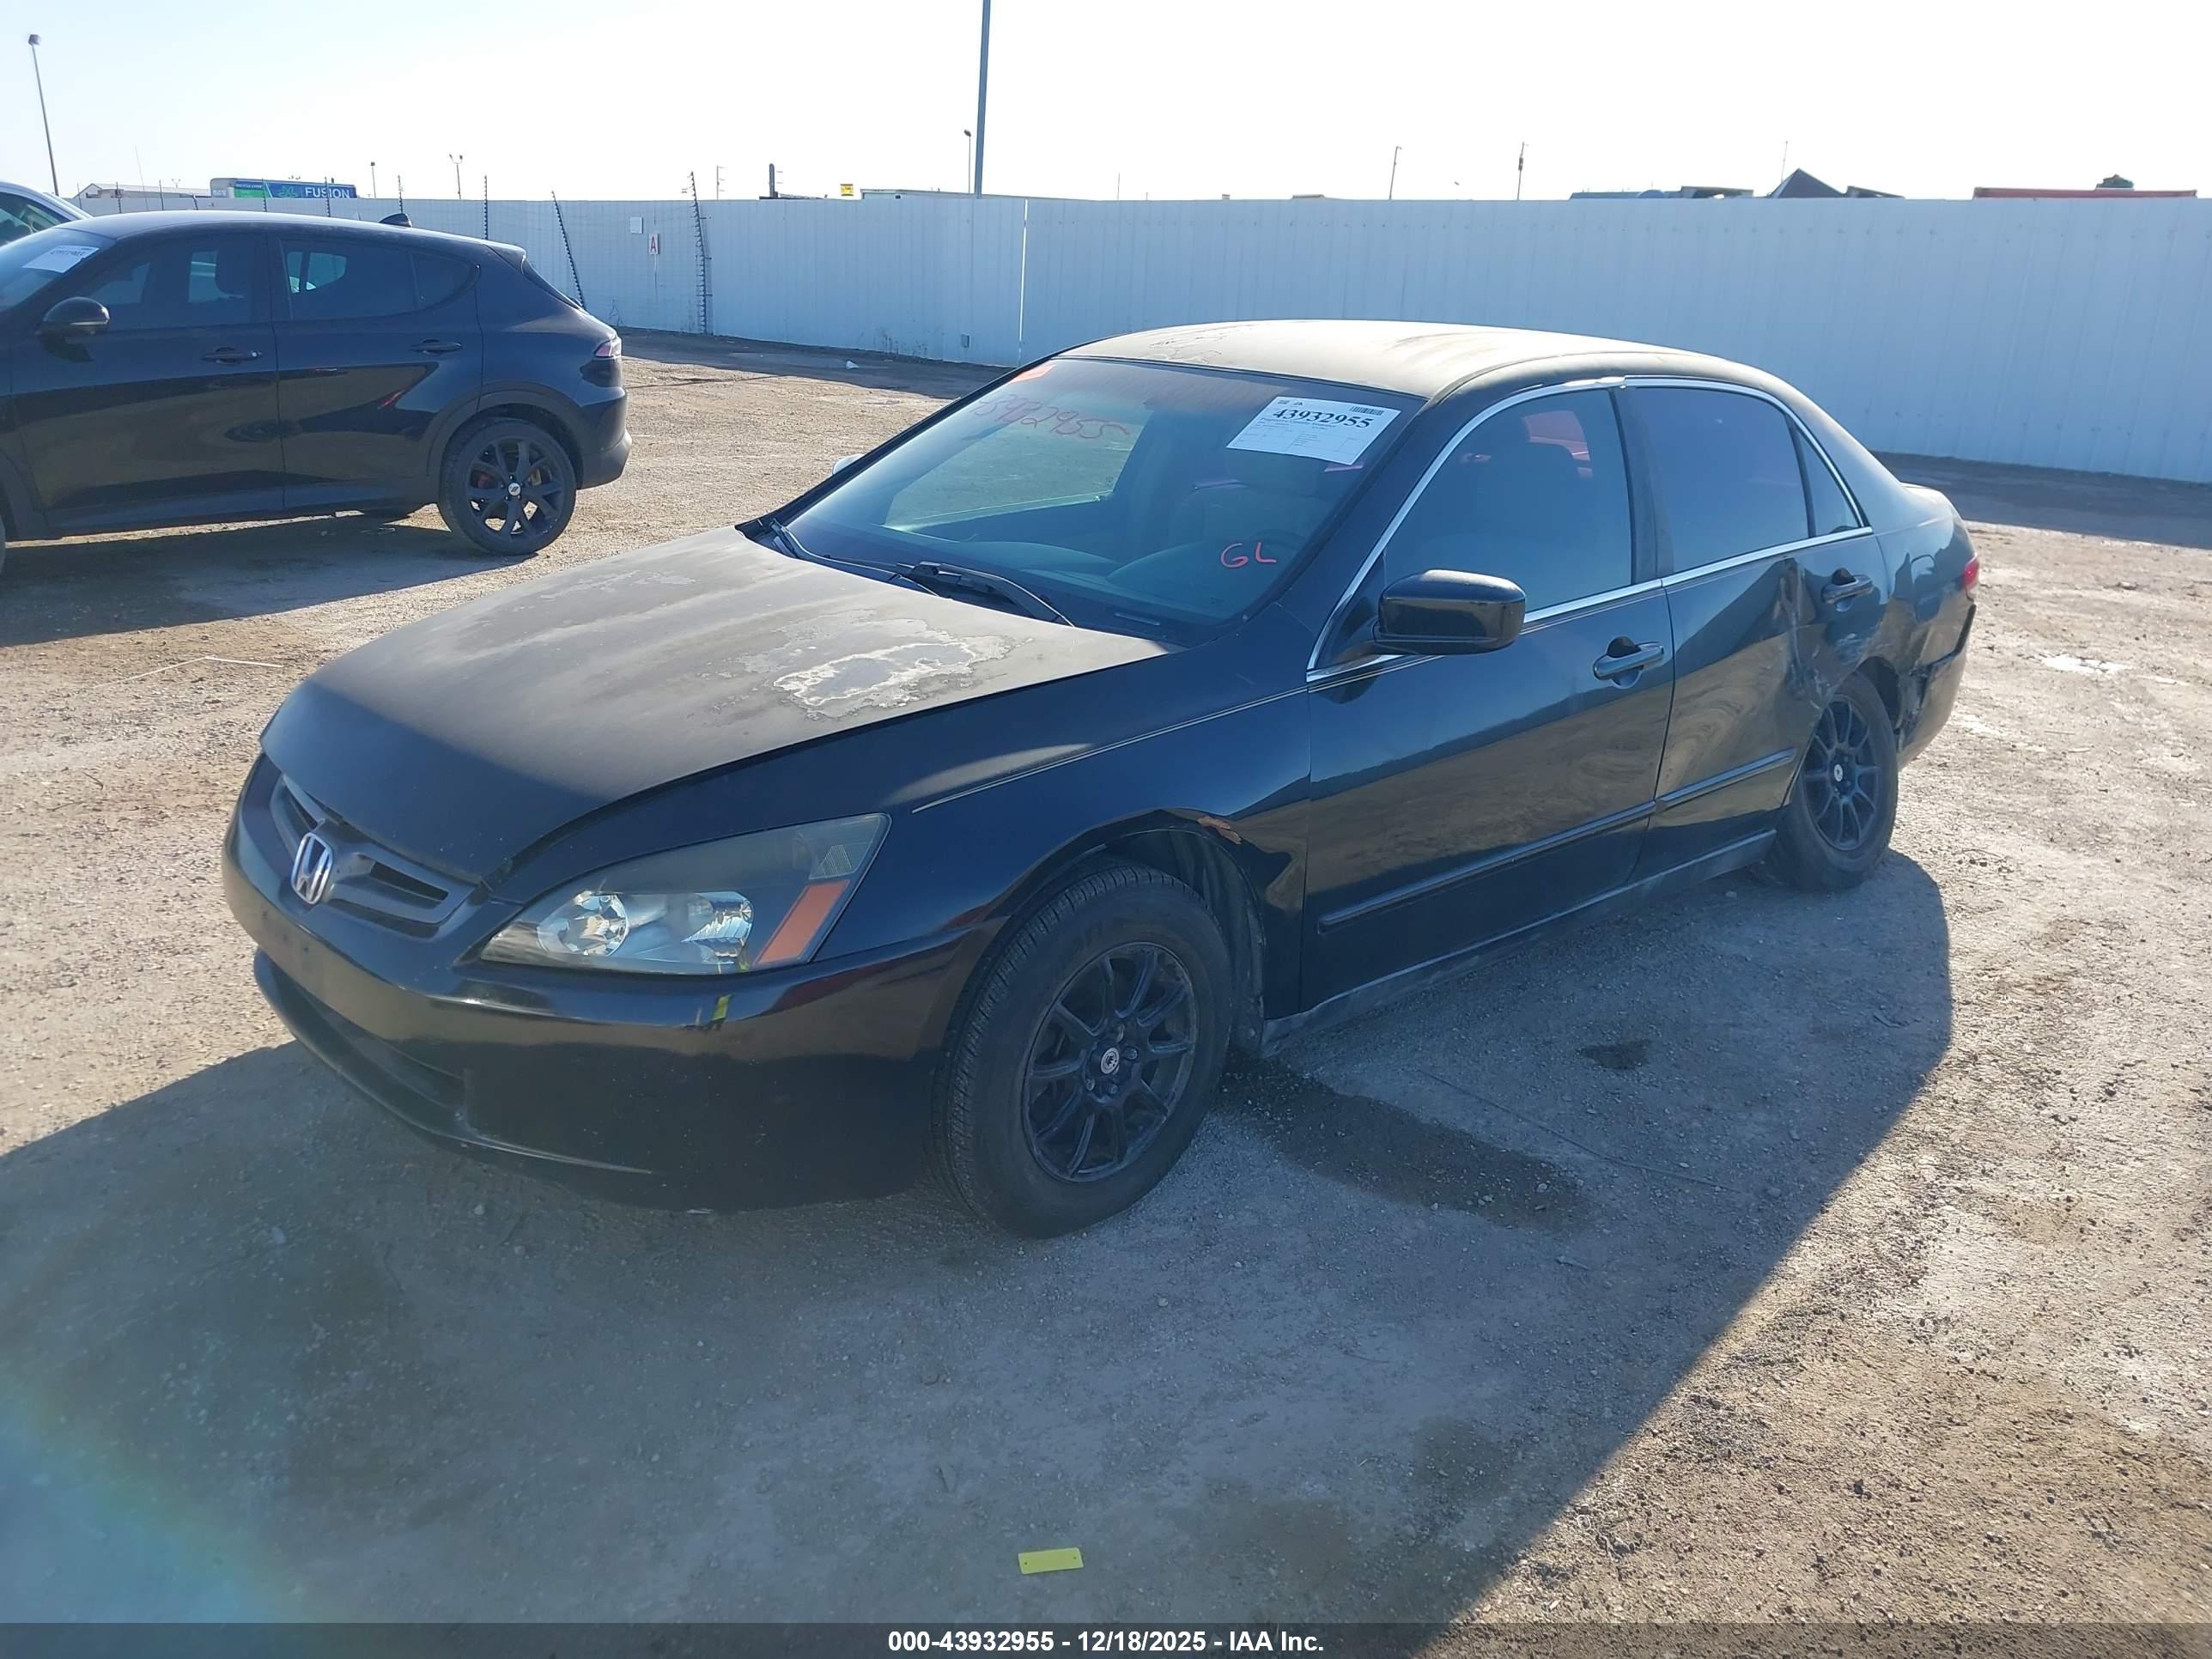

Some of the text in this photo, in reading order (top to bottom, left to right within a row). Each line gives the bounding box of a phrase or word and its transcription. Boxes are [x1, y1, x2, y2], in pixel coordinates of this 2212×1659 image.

[305, 186, 350, 198] FUSION
[650, 235, 657, 253] A
[1272, 408, 1376, 428] 43932955
